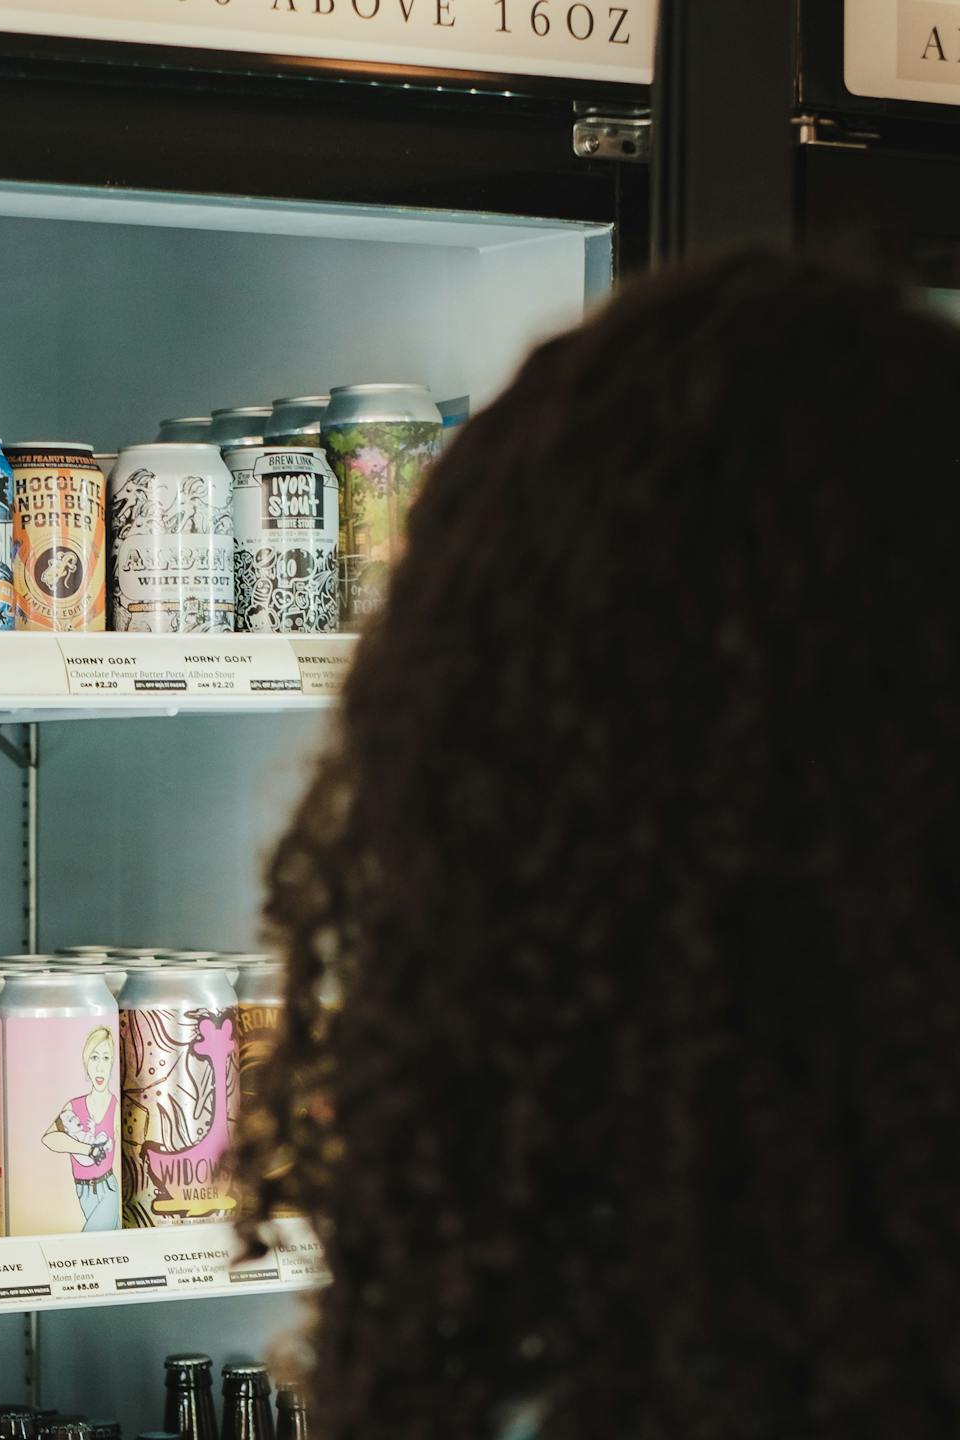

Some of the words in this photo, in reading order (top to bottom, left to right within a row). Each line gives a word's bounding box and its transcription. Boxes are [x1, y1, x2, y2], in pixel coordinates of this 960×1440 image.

[33, 455, 64, 464] PEANUT
[268, 455, 294, 466] BREW
[296, 455, 314, 466] LINK
[271, 472, 316, 496] IVORY
[21, 512, 92, 532] PORTER
[297, 519, 315, 529] STOUT
[137, 575, 189, 587] WHITE
[193, 575, 230, 587] STOUT
[67, 657, 104, 665] HORNY
[107, 657, 137, 665] GOAT
[224, 656, 253, 664] GOAT
[70, 670, 109, 679] Chocolate
[111, 670, 138, 679] Peanut
[140, 670, 164, 679] Butter
[188, 670, 213, 679] Albino
[214, 670, 235, 679] Stout
[182, 1186, 219, 1201] WAGER
[163, 1249, 230, 1262] OOZLEFINCH
[49, 1259, 78, 1269] HOOF
[81, 1255, 130, 1268] HEARTED
[167, 1264, 201, 1275] Widow's
[52, 1274, 71, 1282] Mom
[72, 1273, 95, 1283] Jeans
